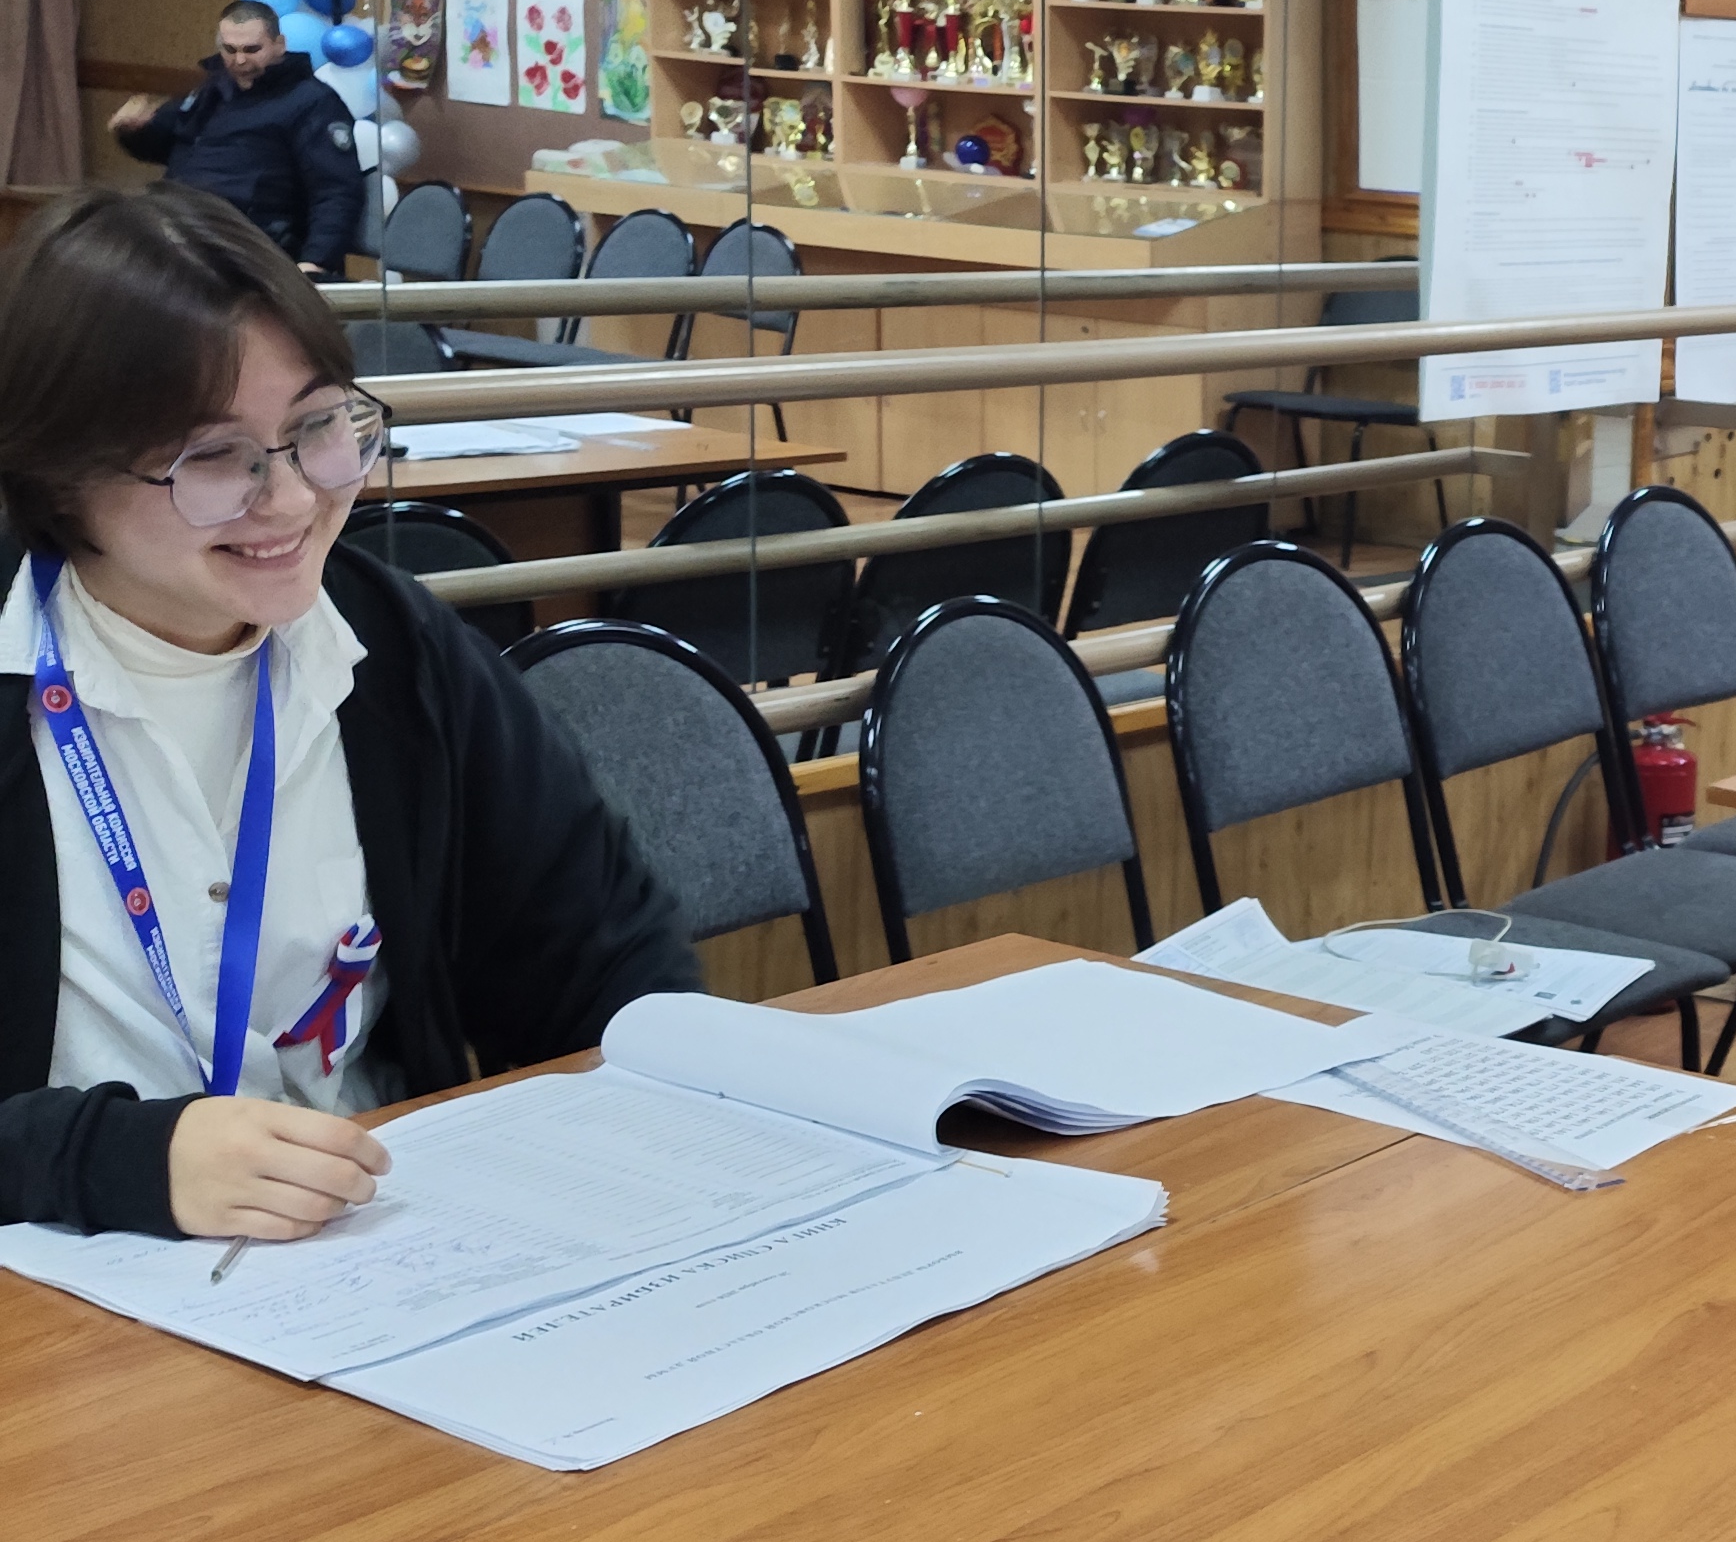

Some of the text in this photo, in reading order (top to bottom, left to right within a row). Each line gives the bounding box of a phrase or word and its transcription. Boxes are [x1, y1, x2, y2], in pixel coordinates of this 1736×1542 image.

[61, 744, 120, 865] МОСКОВСКОЙ ОБЛАСТИ
[71, 726, 138, 872] ИЗБИРАТЕЛЬНАЯ КОМИССИЯ
[511, 1217, 848, 1343] КНИГА СПИСКА ИЗБИРАТЕЛЕЙ
